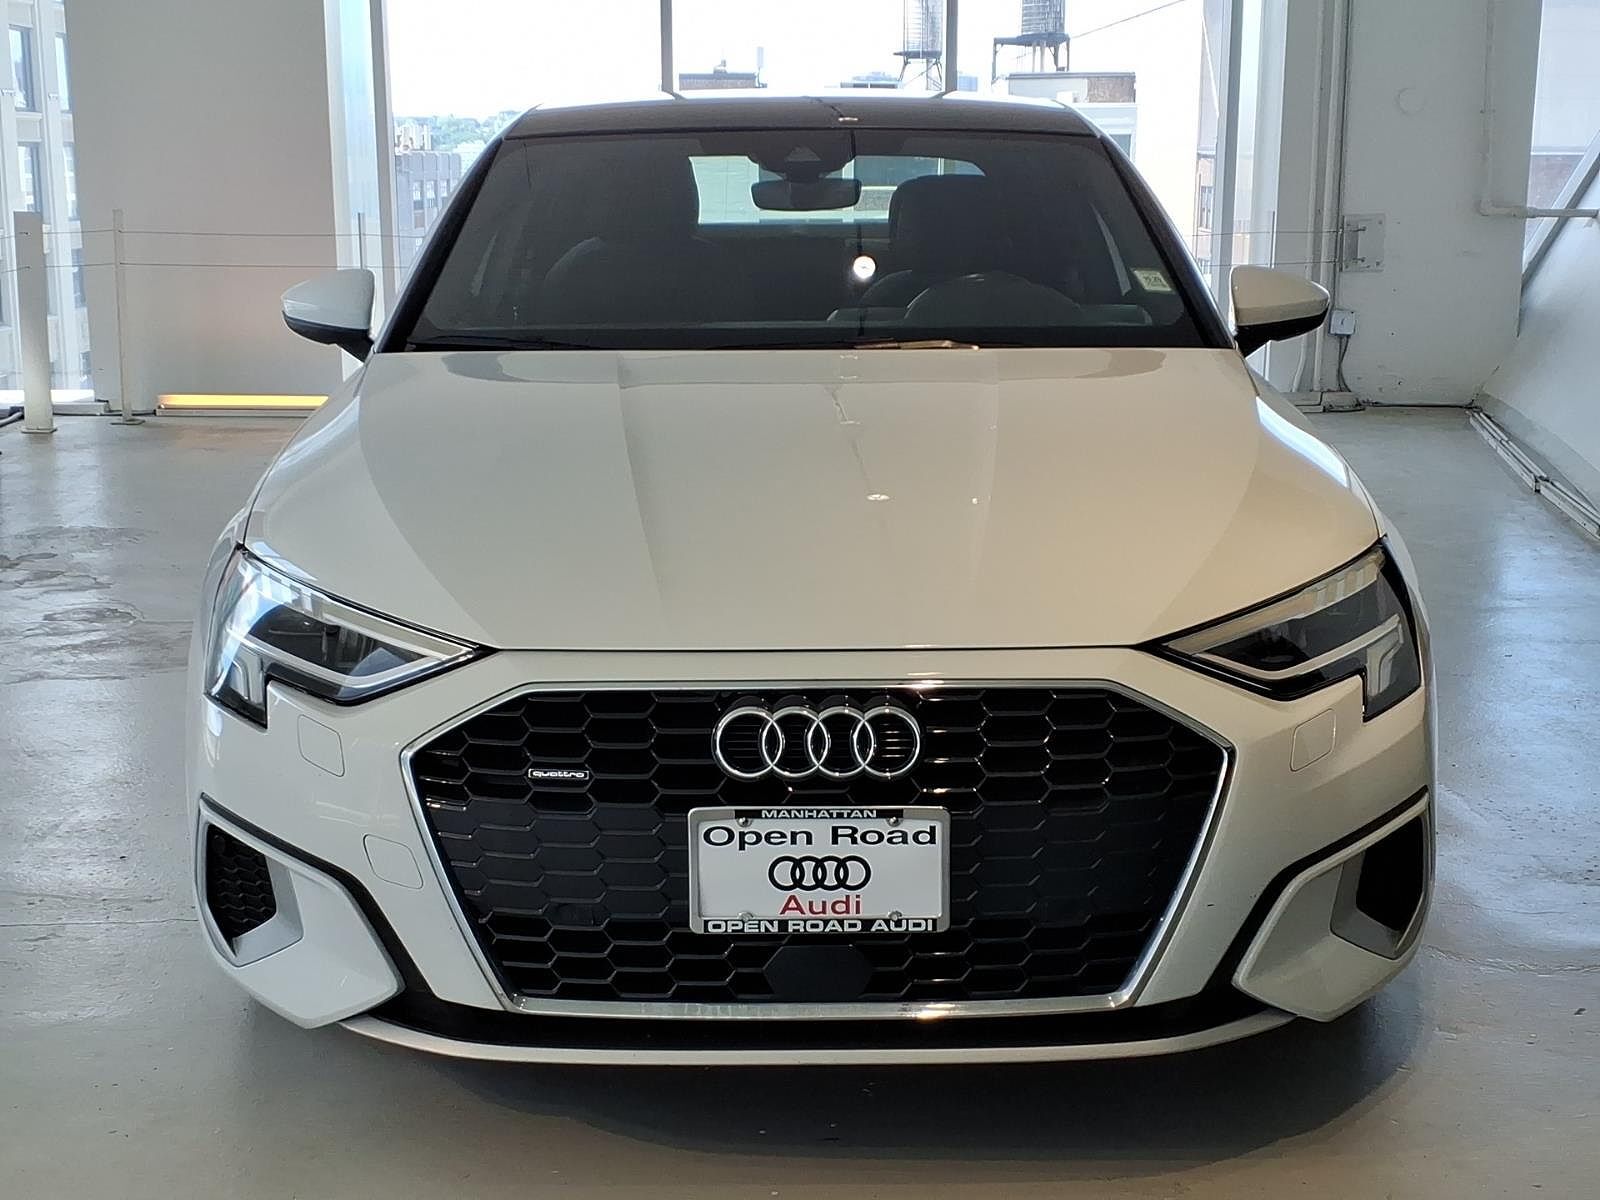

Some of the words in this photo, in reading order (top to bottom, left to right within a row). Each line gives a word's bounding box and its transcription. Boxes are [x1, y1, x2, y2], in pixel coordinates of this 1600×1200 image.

[761, 809, 877, 818] MANHATTAN
[703, 825, 813, 851] Open
[831, 825, 937, 845] Road
[779, 894, 862, 915] Audi
[707, 919, 779, 933] OPEN
[788, 919, 856, 933] ROAD
[870, 918, 933, 932] AUDI
